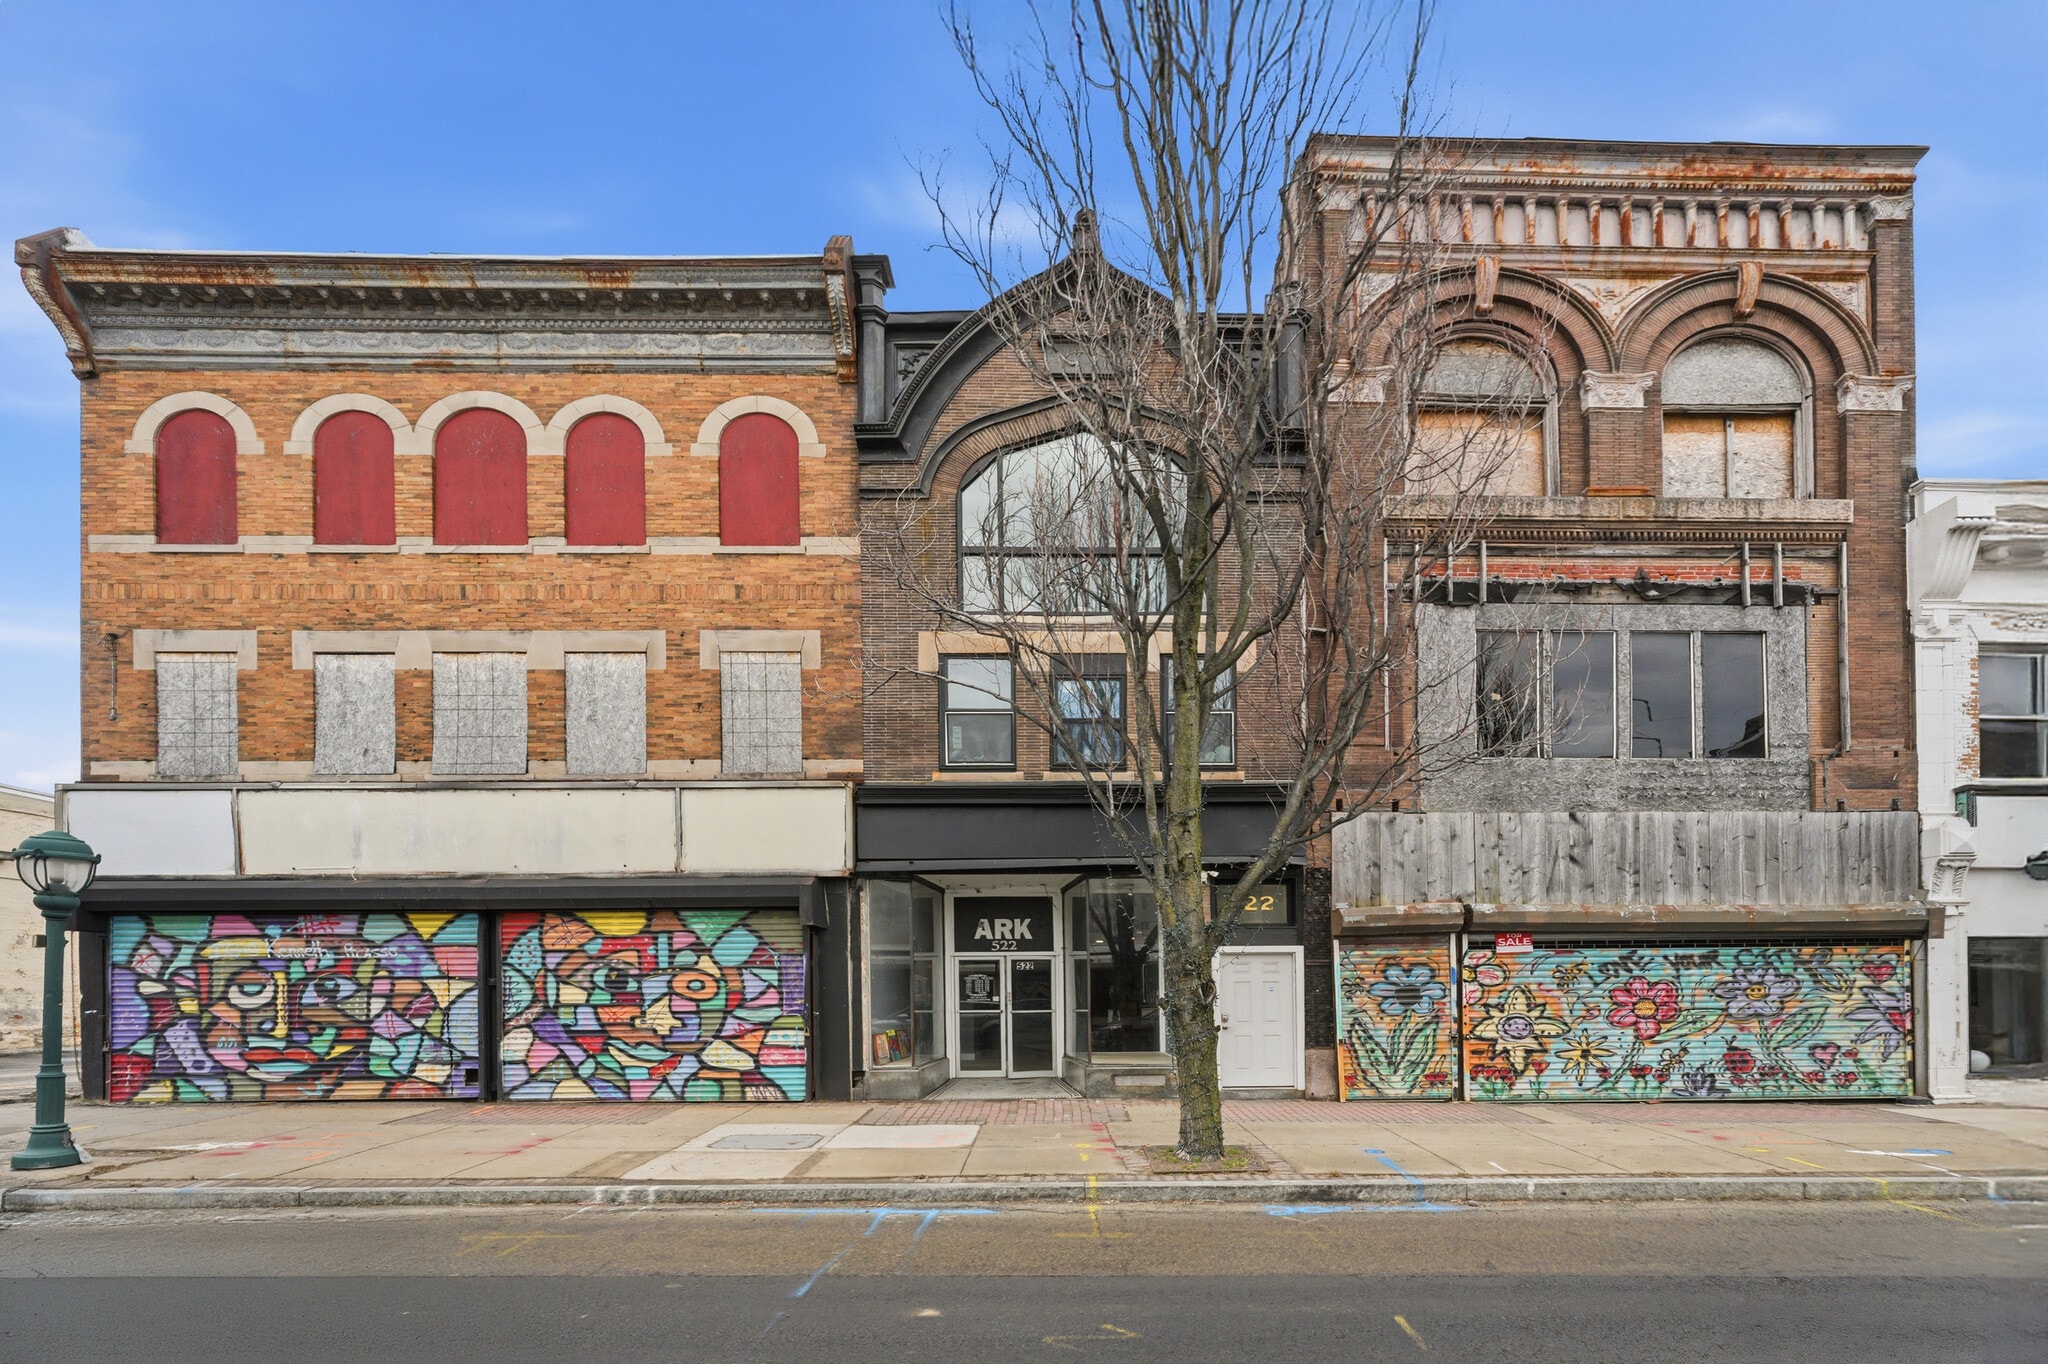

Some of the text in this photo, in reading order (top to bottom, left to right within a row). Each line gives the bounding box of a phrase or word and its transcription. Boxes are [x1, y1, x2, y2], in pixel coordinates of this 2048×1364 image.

[1243, 895, 1275, 911] 22
[974, 918, 1033, 940] ARK
[990, 940, 1018, 951] 522
[1497, 937, 1533, 946] SALE
[1016, 961, 1034, 970] 522
